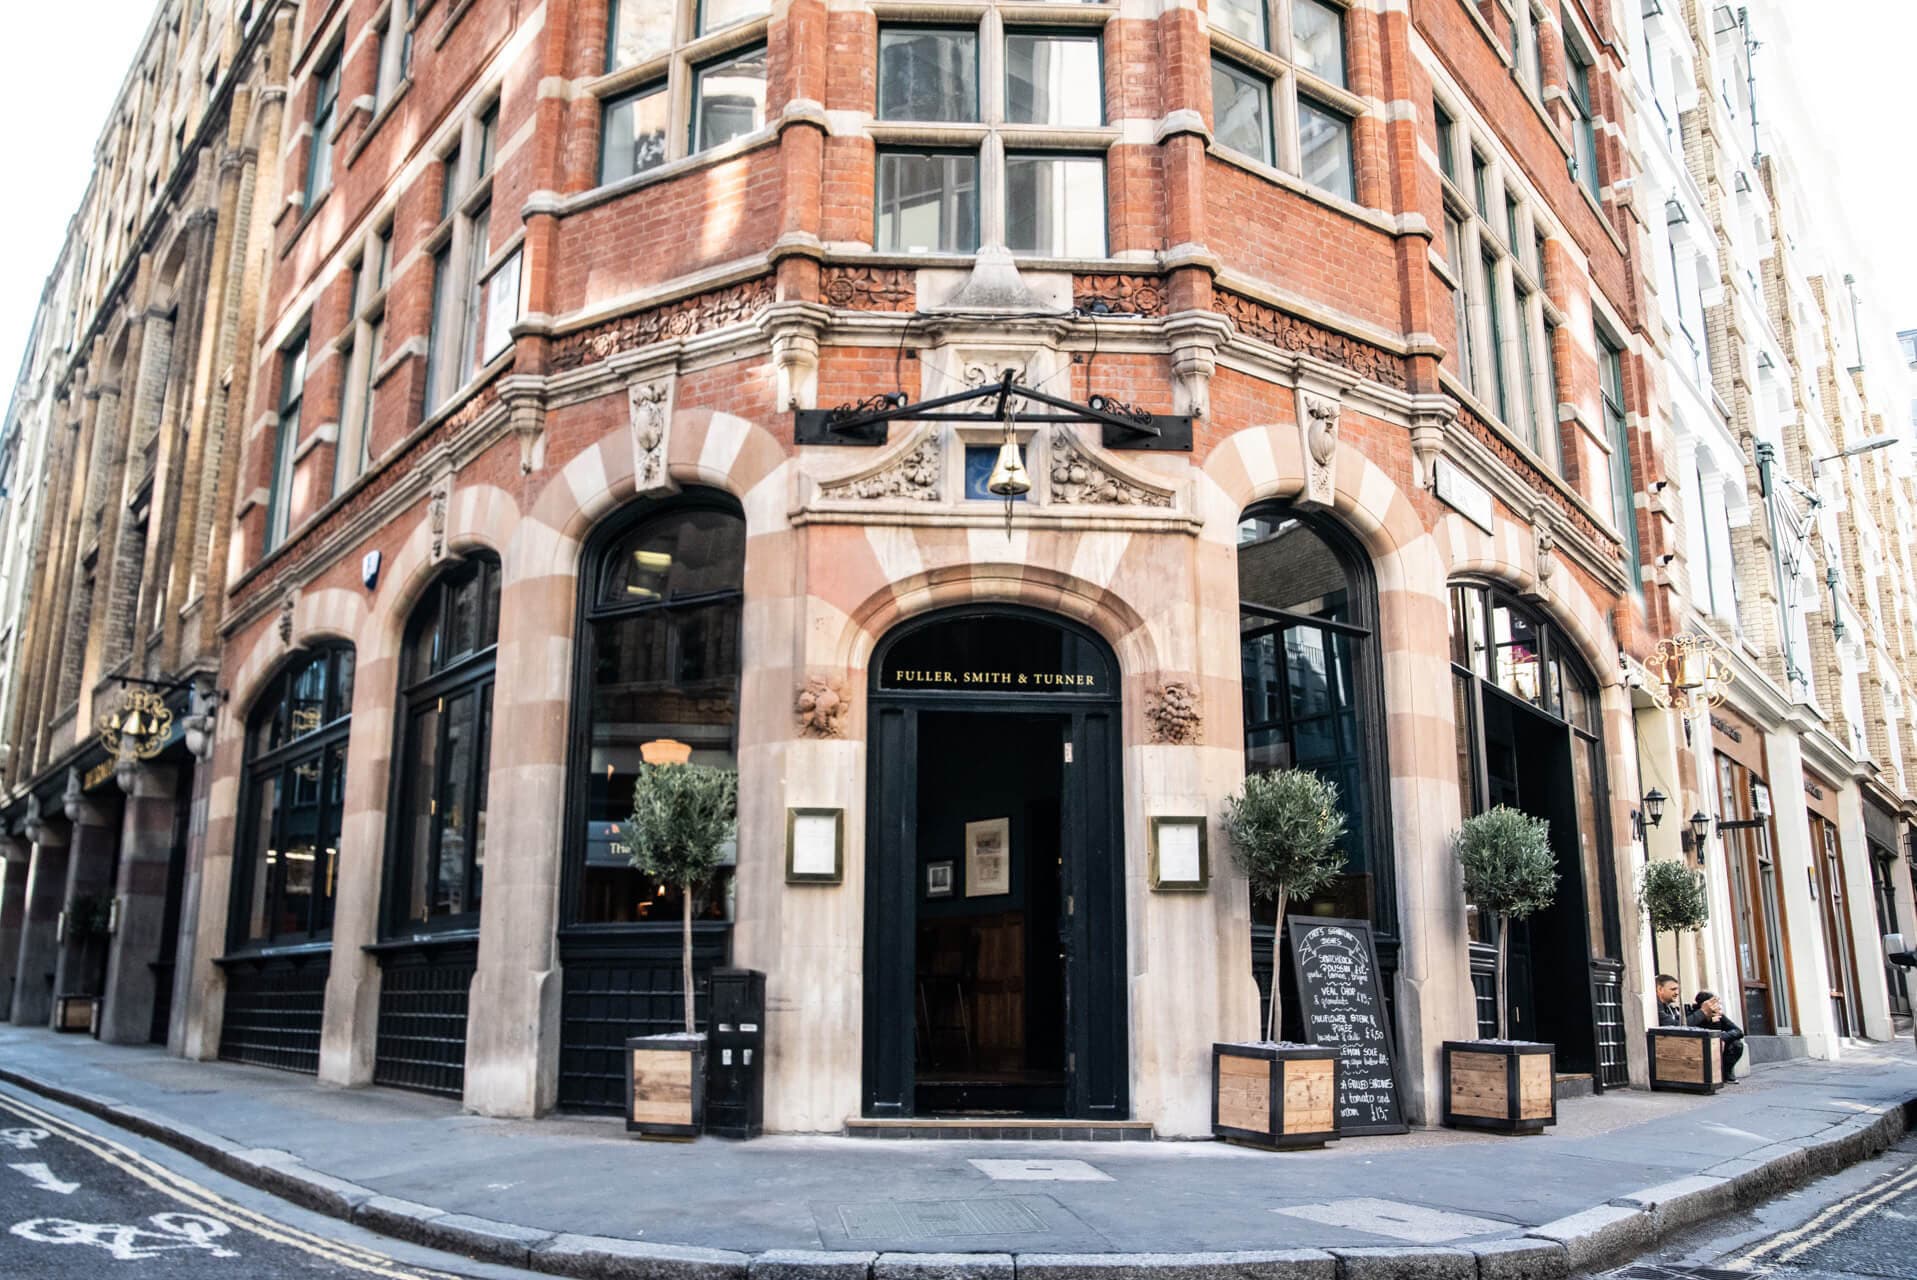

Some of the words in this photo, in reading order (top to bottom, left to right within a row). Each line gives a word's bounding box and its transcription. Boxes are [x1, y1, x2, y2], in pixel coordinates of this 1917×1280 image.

[896, 670, 957, 684] FULLER,
[963, 672, 1012, 684] SMITH
[1017, 673, 1028, 685] &
[1034, 673, 1095, 686] TURNER
[1321, 986, 1338, 996] VEAL
[1341, 986, 1356, 996] CHOP
[1363, 1047, 1378, 1057] SOLE
[1349, 1091, 1375, 1104] tomato
